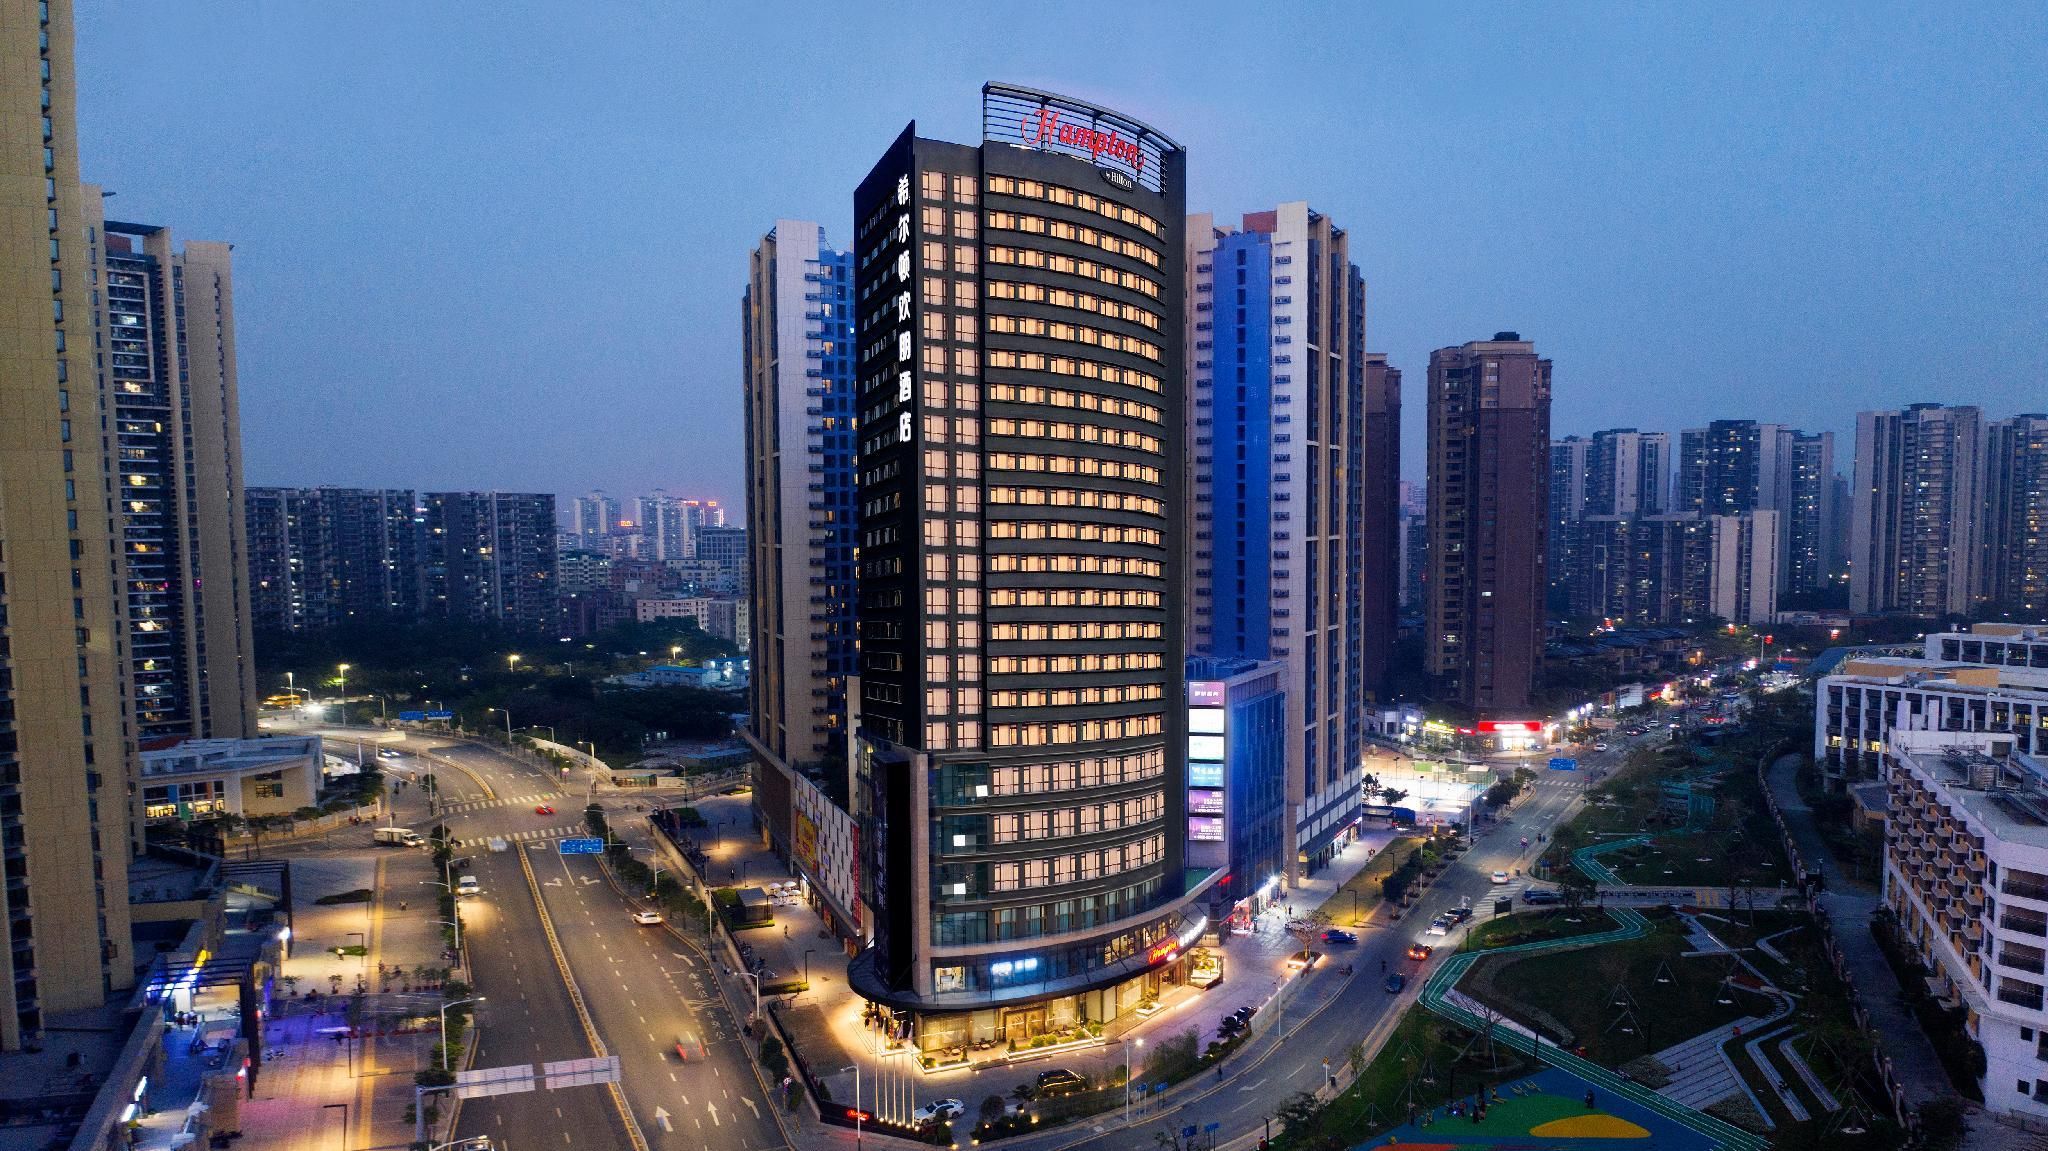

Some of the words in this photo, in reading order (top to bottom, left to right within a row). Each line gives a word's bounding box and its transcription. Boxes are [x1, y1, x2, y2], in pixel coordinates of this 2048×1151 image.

[1021, 108, 1146, 170] Hampton
[1111, 171, 1132, 189] Hilton
[897, 173, 911, 443] 希尔顿欢朋酒店
